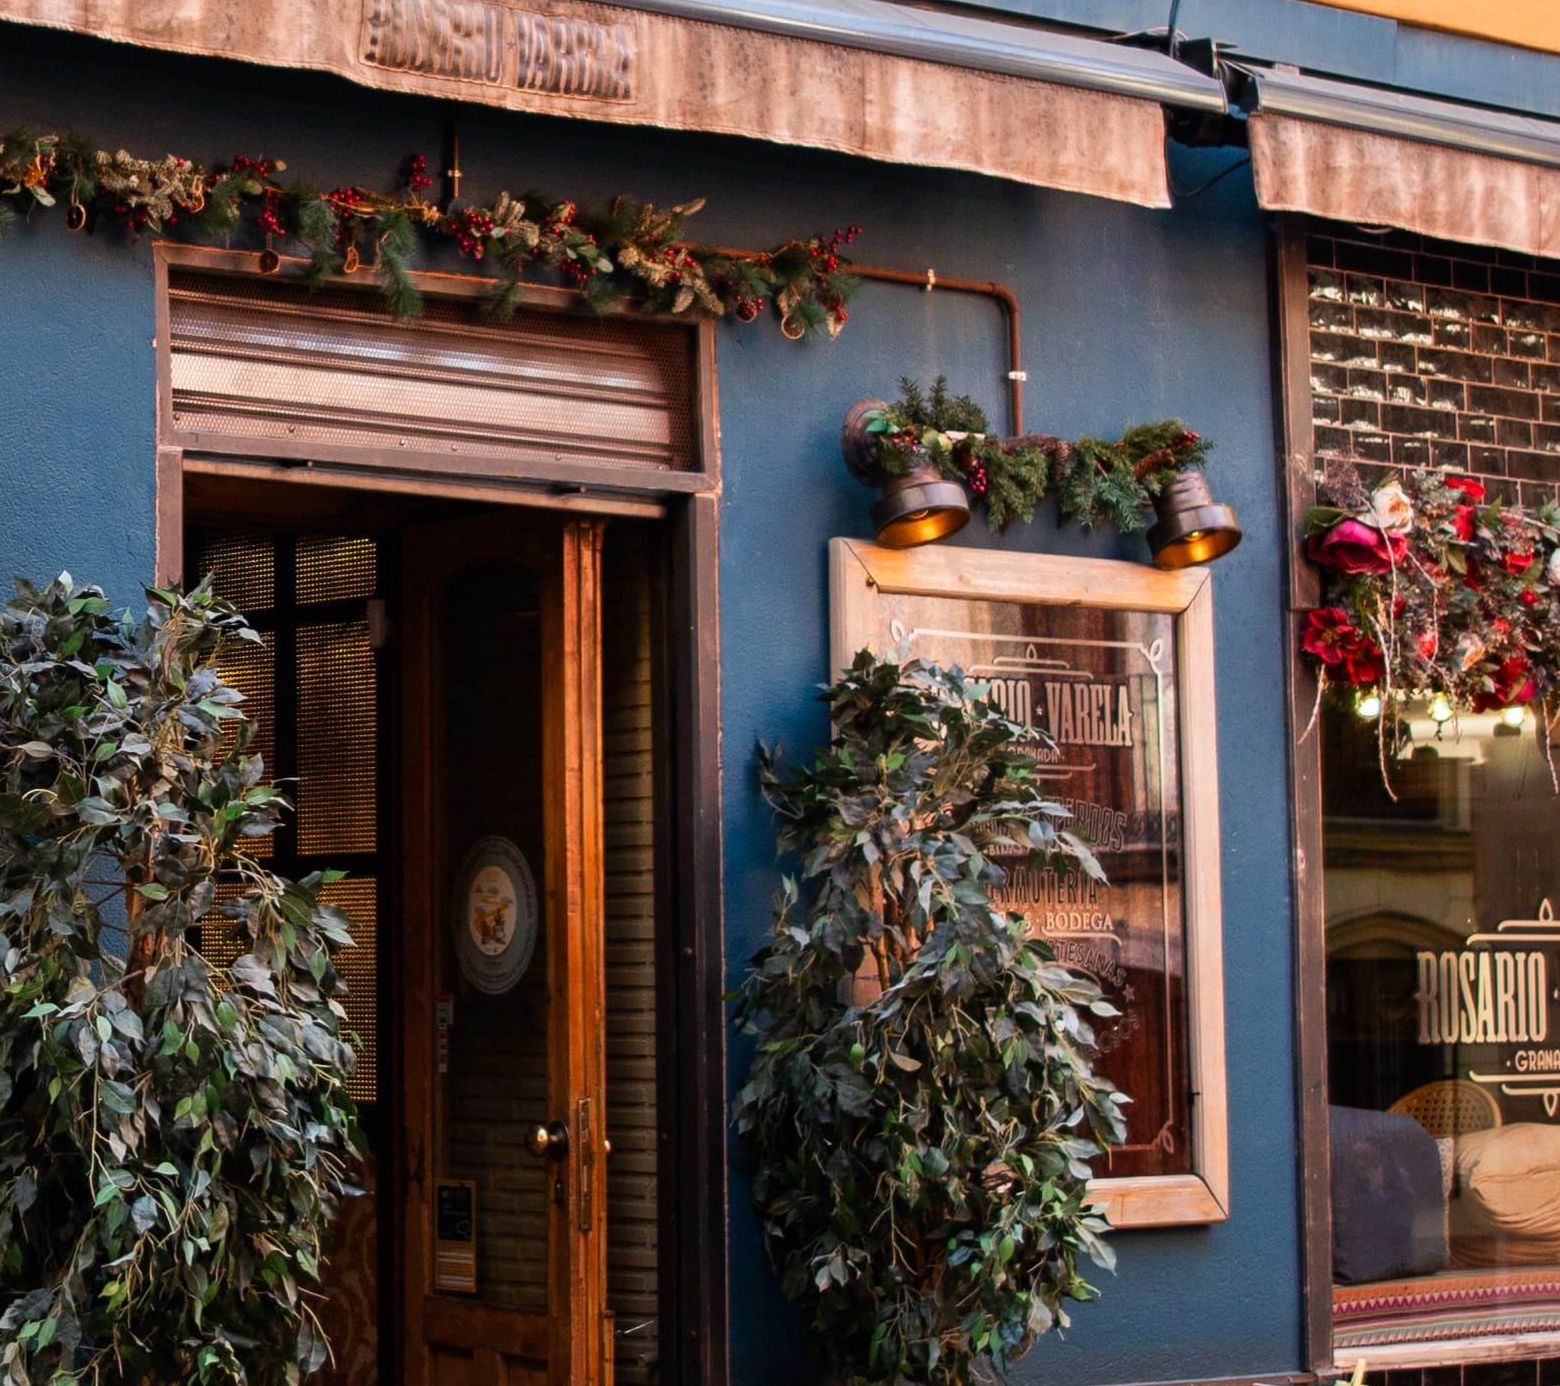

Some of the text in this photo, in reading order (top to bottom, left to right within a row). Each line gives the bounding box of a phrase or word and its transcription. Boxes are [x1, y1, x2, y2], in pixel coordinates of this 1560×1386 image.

[1045, 681, 1134, 746] VARELA
[1046, 913, 1114, 930] BODEGA
[1414, 951, 1547, 1044] ROSARIO
